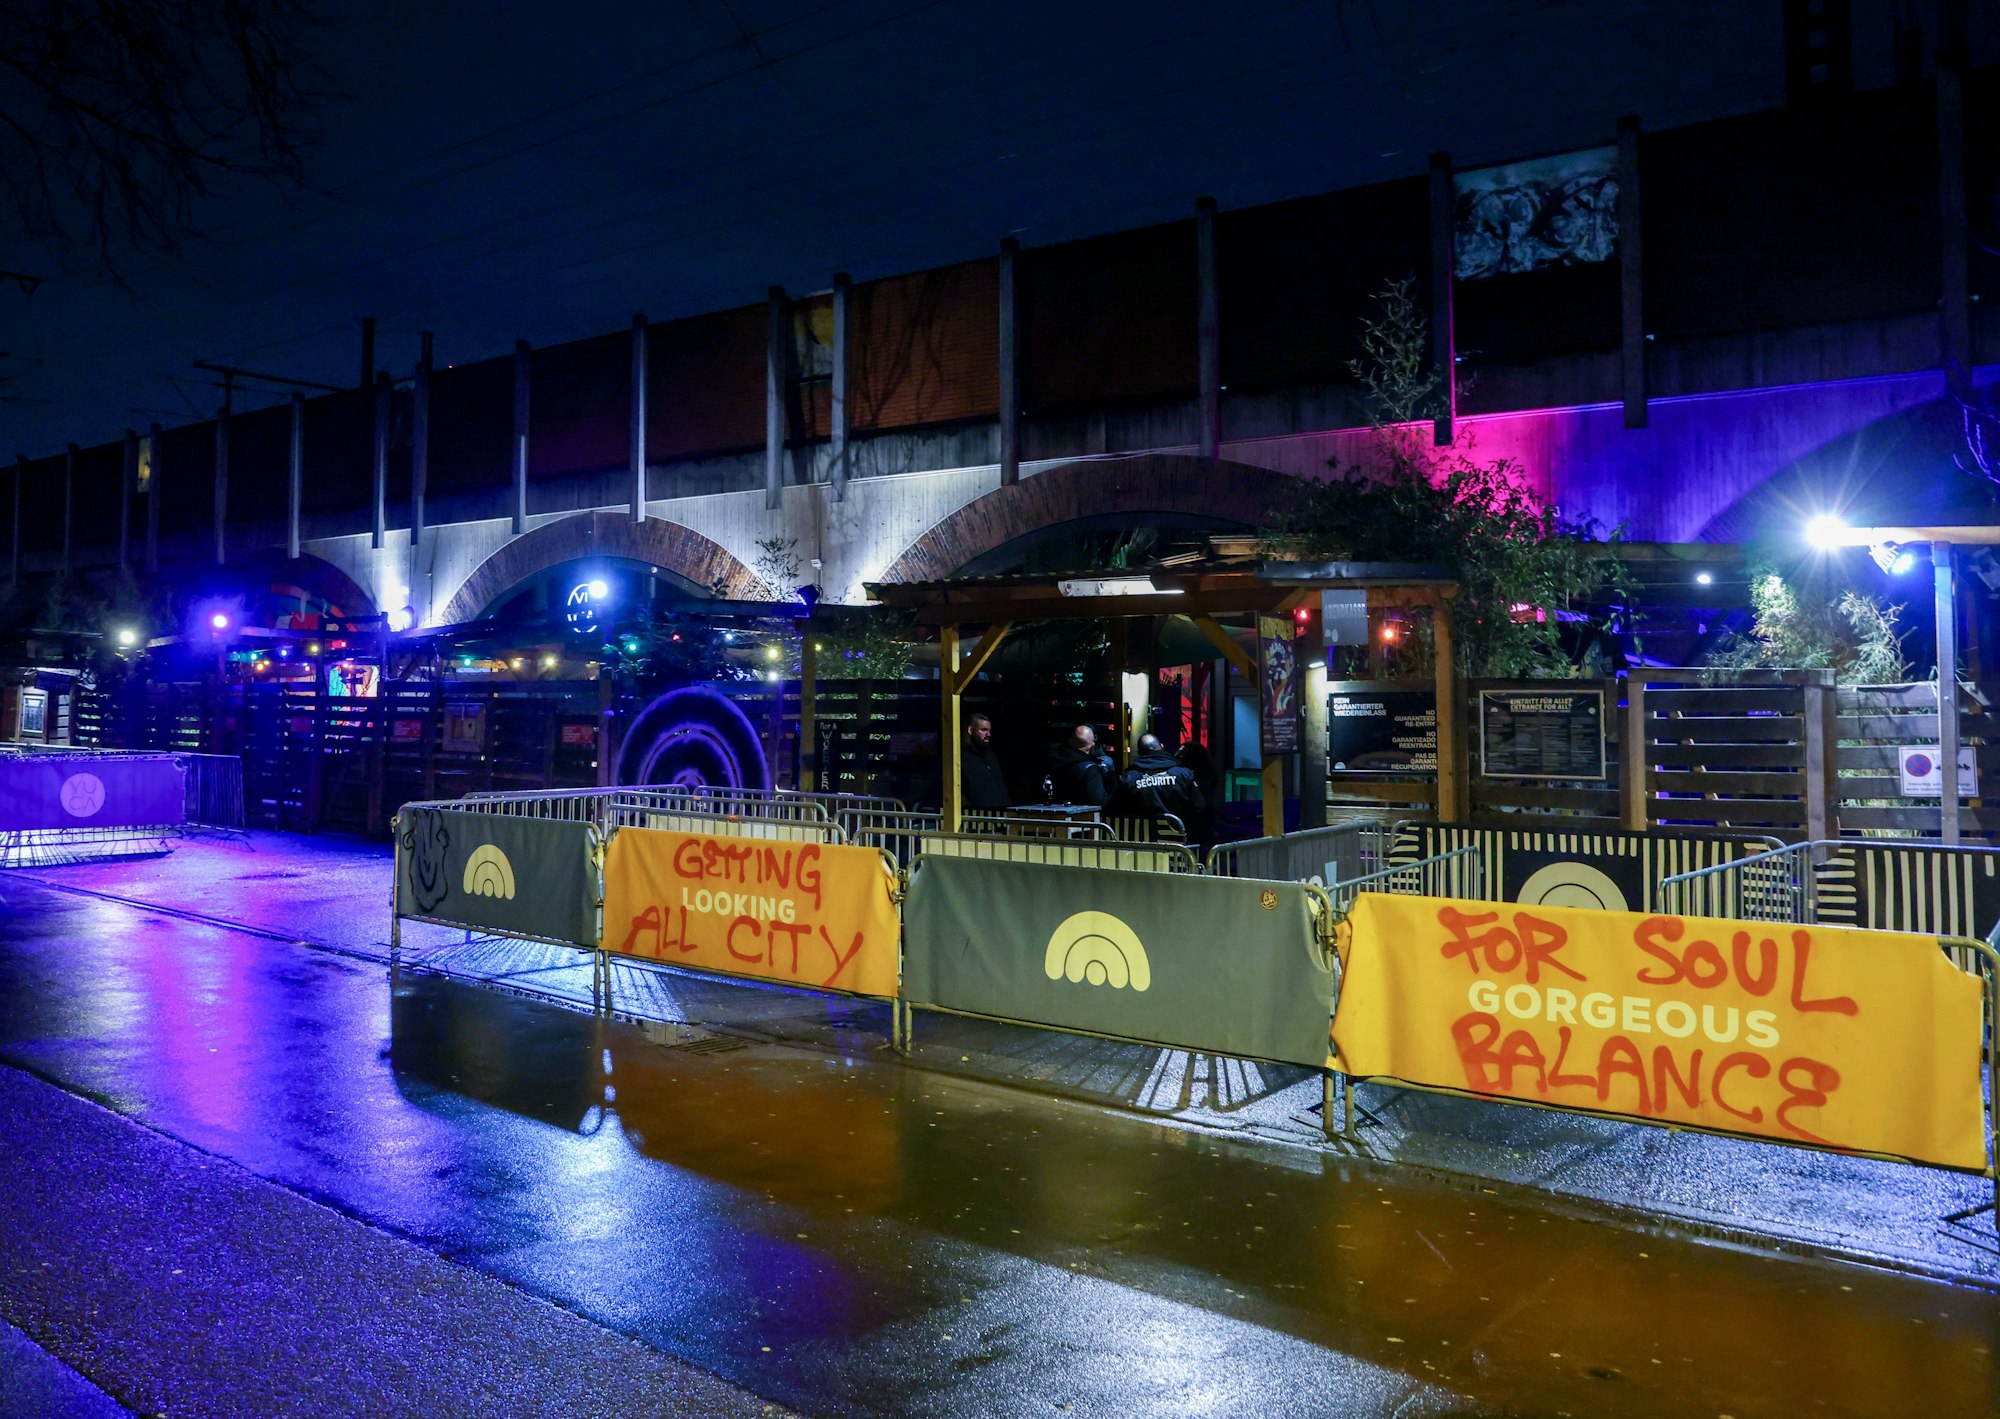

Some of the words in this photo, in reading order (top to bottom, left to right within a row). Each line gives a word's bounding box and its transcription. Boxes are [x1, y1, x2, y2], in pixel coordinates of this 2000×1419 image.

[1333, 703, 1384, 711] GARANTIERTER
[1333, 709, 1387, 717] WIEDEREINLASS
[1391, 736, 1437, 744] GARANTIZADO
[1136, 775, 1176, 789] SECURITY
[673, 839, 822, 911] GETTING
[682, 886, 796, 925] LOOKING
[622, 905, 698, 957] ALL
[727, 914, 864, 991] CITY
[1437, 906, 1588, 985] FOR
[1633, 916, 1859, 1016] SOUL
[1468, 979, 1780, 1049] GORGEOUS
[1451, 1011, 1851, 1151] BALANCE
